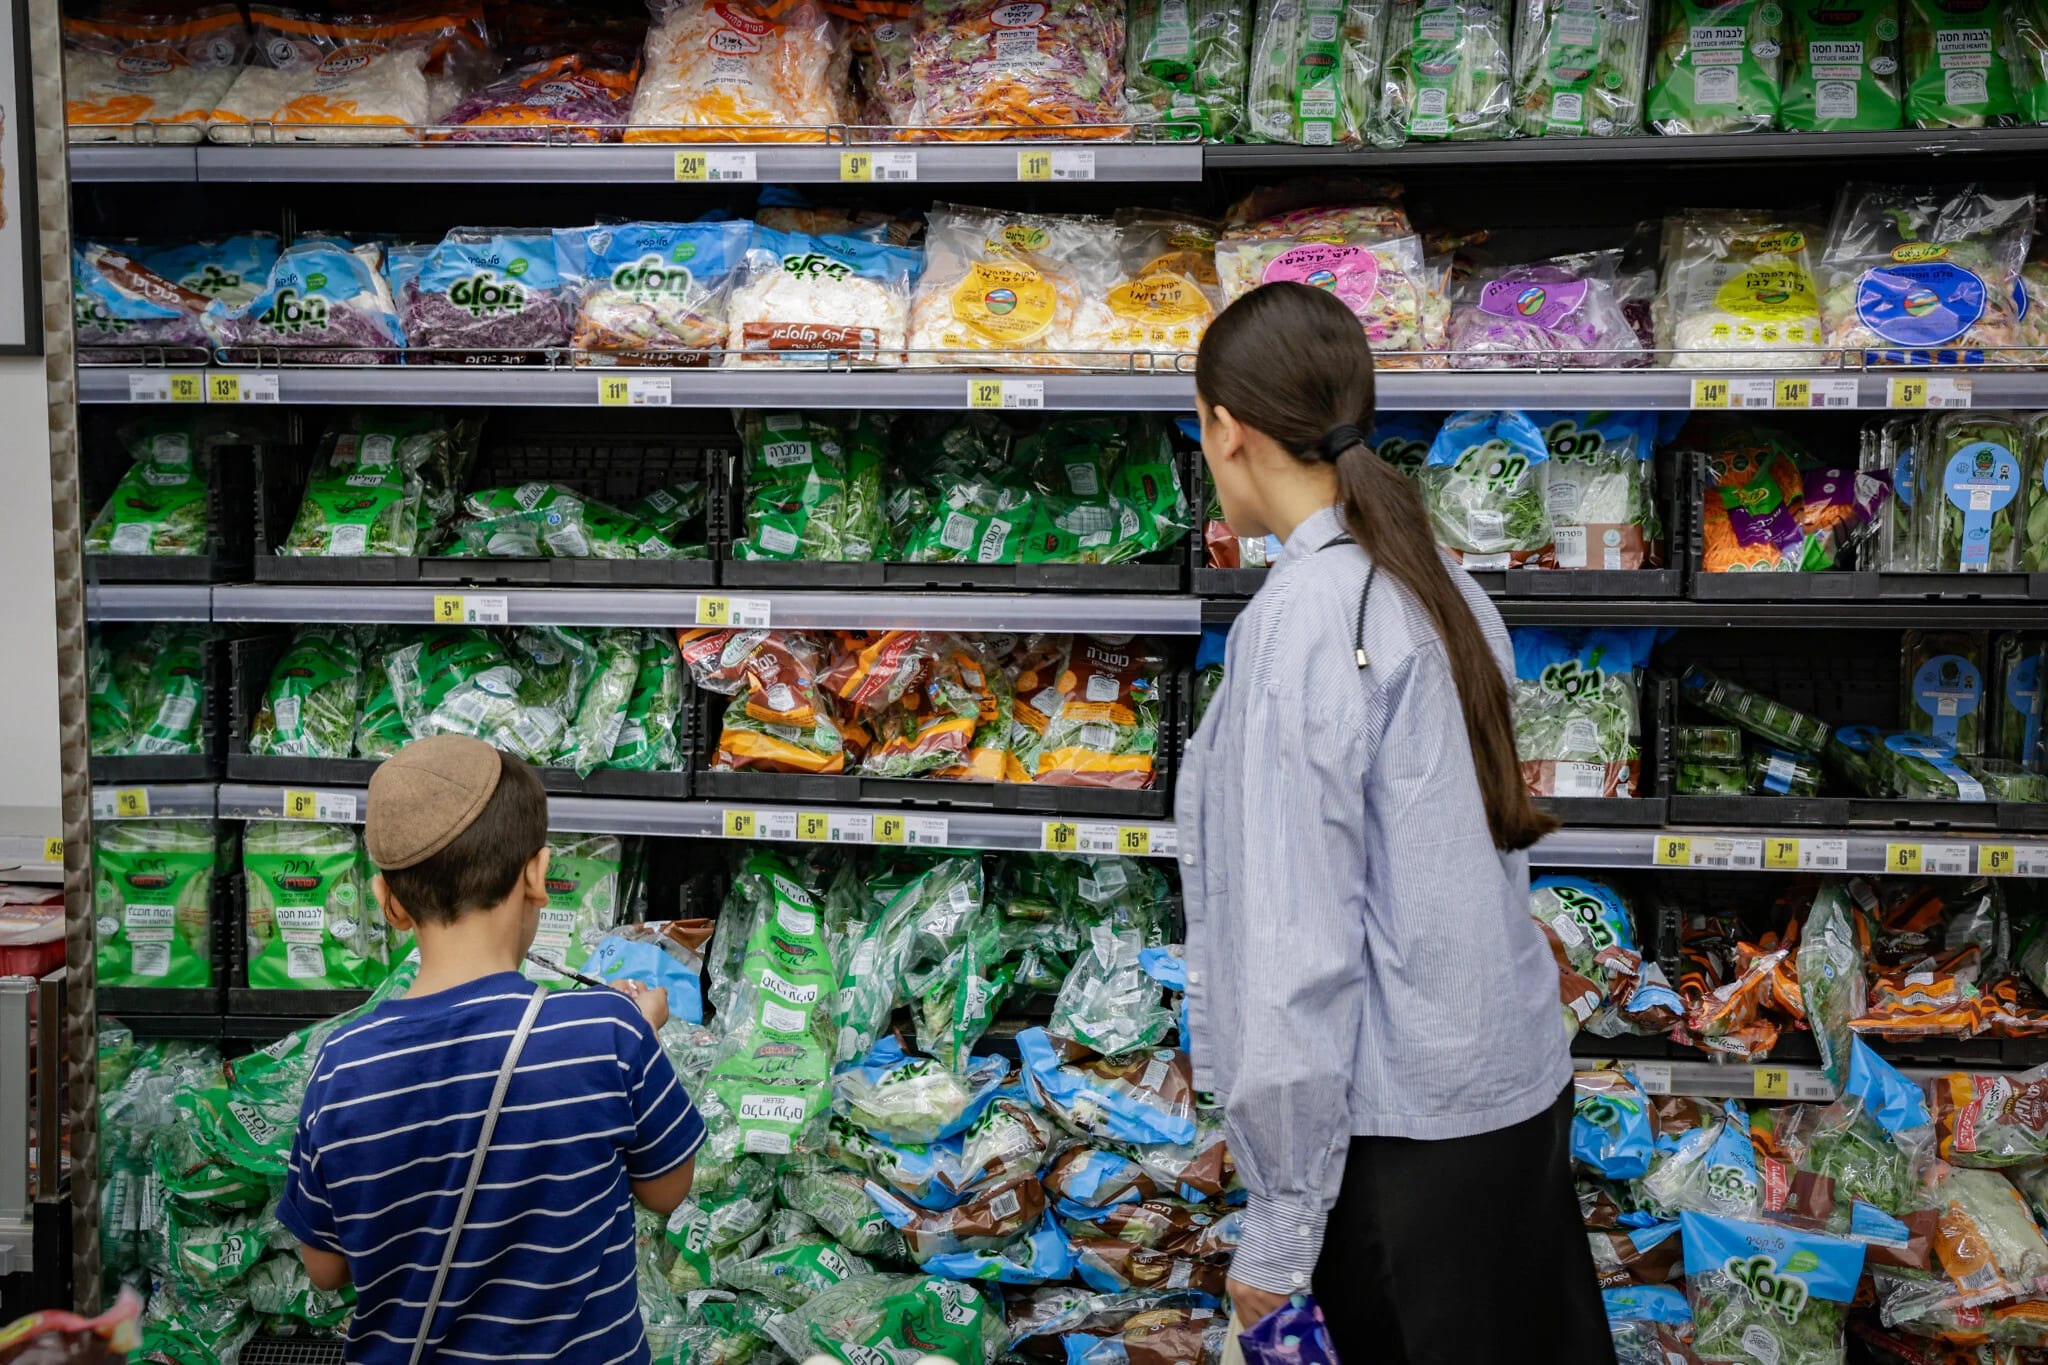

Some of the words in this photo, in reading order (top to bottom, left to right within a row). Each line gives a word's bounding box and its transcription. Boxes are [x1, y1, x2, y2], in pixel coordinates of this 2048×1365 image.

[1010, 4, 1029, 12] לקט
[1692, 30, 1713, 40] חסה
[1715, 27, 1743, 38] לבבות
[1939, 33, 1960, 42] חסה
[1963, 30, 1989, 41] לבבות
[1812, 44, 1833, 53] חסה
[1835, 43, 1861, 53] לבבות
[683, 157, 697, 174] 24
[852, 157, 859, 174] 9
[1029, 158, 1039, 174] 11
[1279, 254, 1325, 265] קלאסי
[615, 257, 689, 304] חסלט
[1746, 279, 1769, 288] לבן
[450, 273, 525, 317] חסלט
[772, 324, 818, 342] קולסלאו
[822, 327, 851, 343] לקט
[217, 380, 230, 396] 13
[610, 383, 620, 399] 11
[980, 386, 992, 402] 12
[1704, 386, 1717, 401] 14
[1784, 384, 1798, 401] 14
[1904, 386, 1912, 402] 5
[769, 443, 806, 458] כוסברה
[1548, 420, 1602, 465] חסל
[444, 602, 452, 616] 5
[709, 602, 716, 618] 5
[1087, 646, 1129, 667] כוסברה
[296, 796, 304, 811] 6
[735, 816, 742, 831] 6
[808, 818, 816, 834] 5
[885, 820, 892, 835] 6
[1126, 832, 1139, 847] 15
[1669, 842, 1678, 859] 8
[1778, 844, 1784, 859] 7
[1900, 848, 1908, 865] 6
[1991, 850, 2000, 867] 6
[278, 910, 295, 920] חסה
[298, 908, 322, 919] לבבות
[549, 911, 575, 922] לבבות
[1551, 885, 1616, 948] חסלט
[762, 976, 787, 996] סלרי
[790, 990, 816, 1003] עלים
[1766, 1074, 1772, 1089] 7
[762, 1097, 786, 1105] CELERY
[741, 1104, 770, 1119] סלרי
[774, 1105, 803, 1121] עלים
[1729, 1256, 1804, 1322] חסלט
